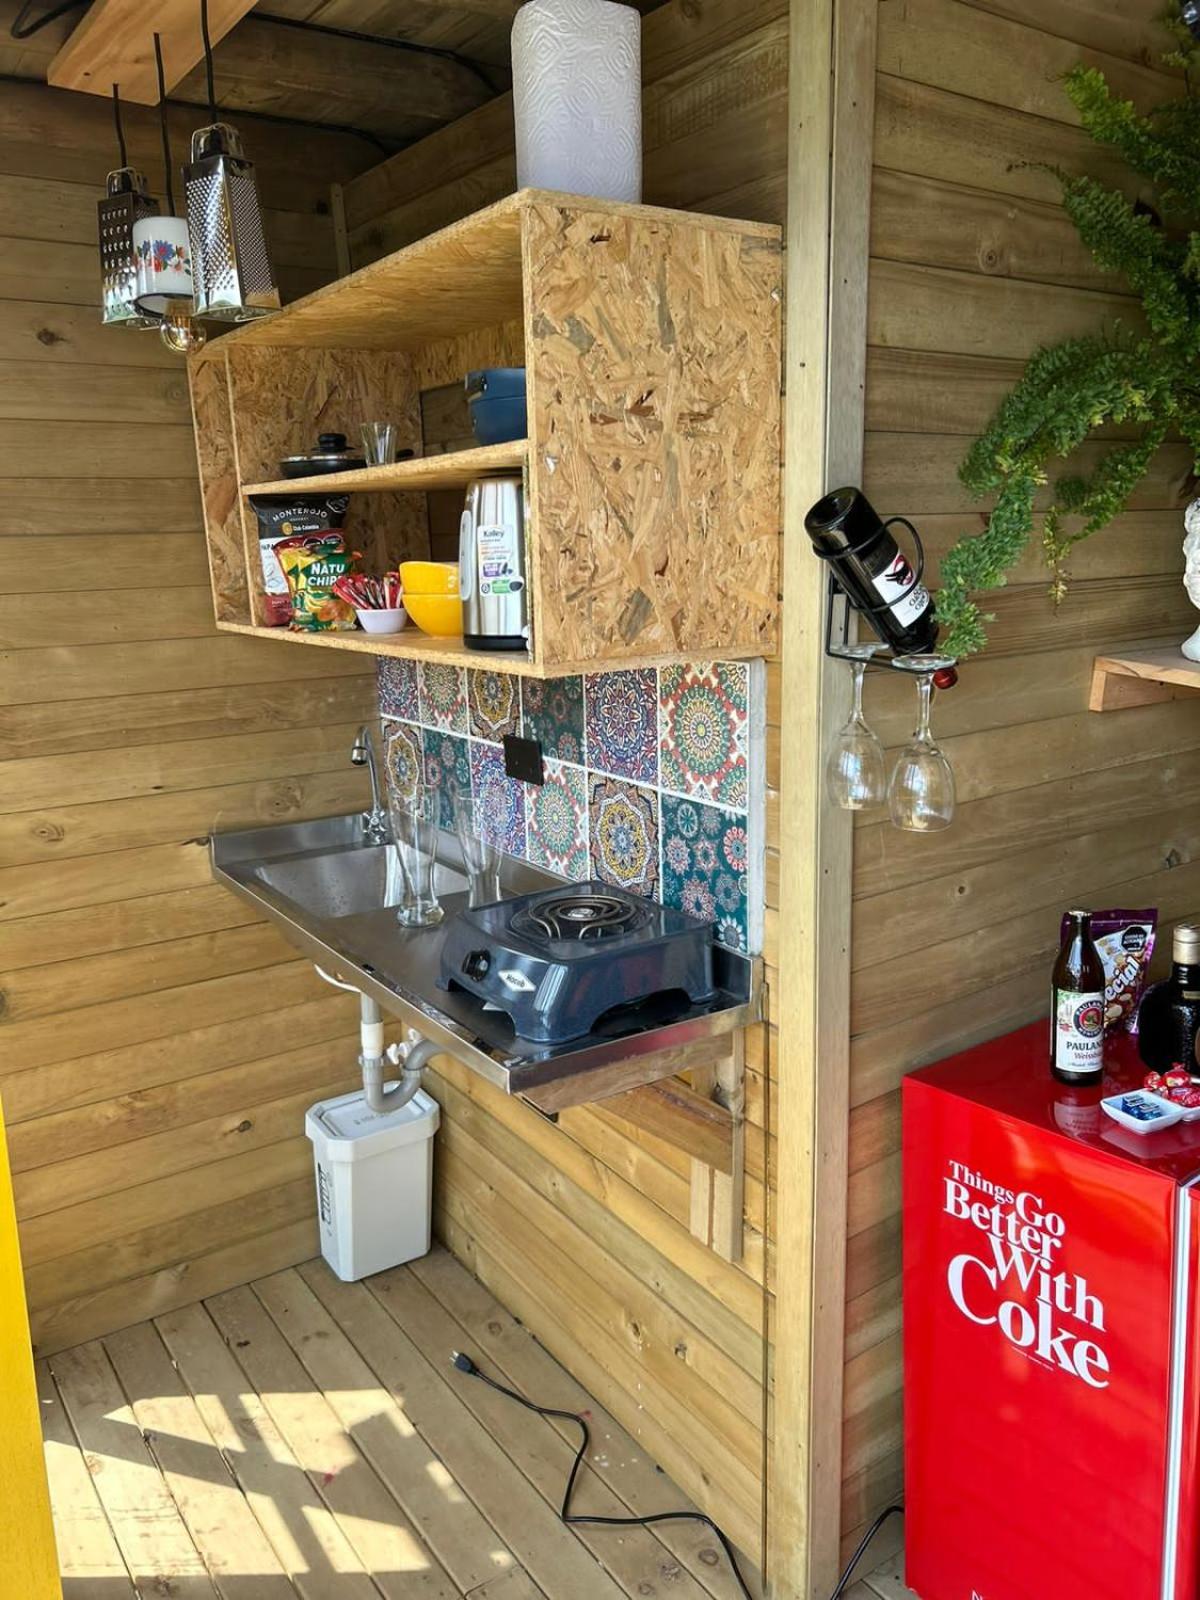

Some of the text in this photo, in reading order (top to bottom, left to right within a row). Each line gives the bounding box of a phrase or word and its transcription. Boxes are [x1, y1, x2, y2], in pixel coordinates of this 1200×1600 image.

[272, 507, 328, 522] MONTEROJO
[307, 575, 341, 587] CHIP
[310, 562, 345, 576] NATU
[1104, 955, 1140, 1002] ecial
[1065, 1041, 1103, 1051] PAULAN
[943, 1177, 1062, 1263] Better
[949, 1159, 1066, 1237] Things Go
[987, 1232, 1107, 1332] With
[947, 1253, 1110, 1389] Coke
